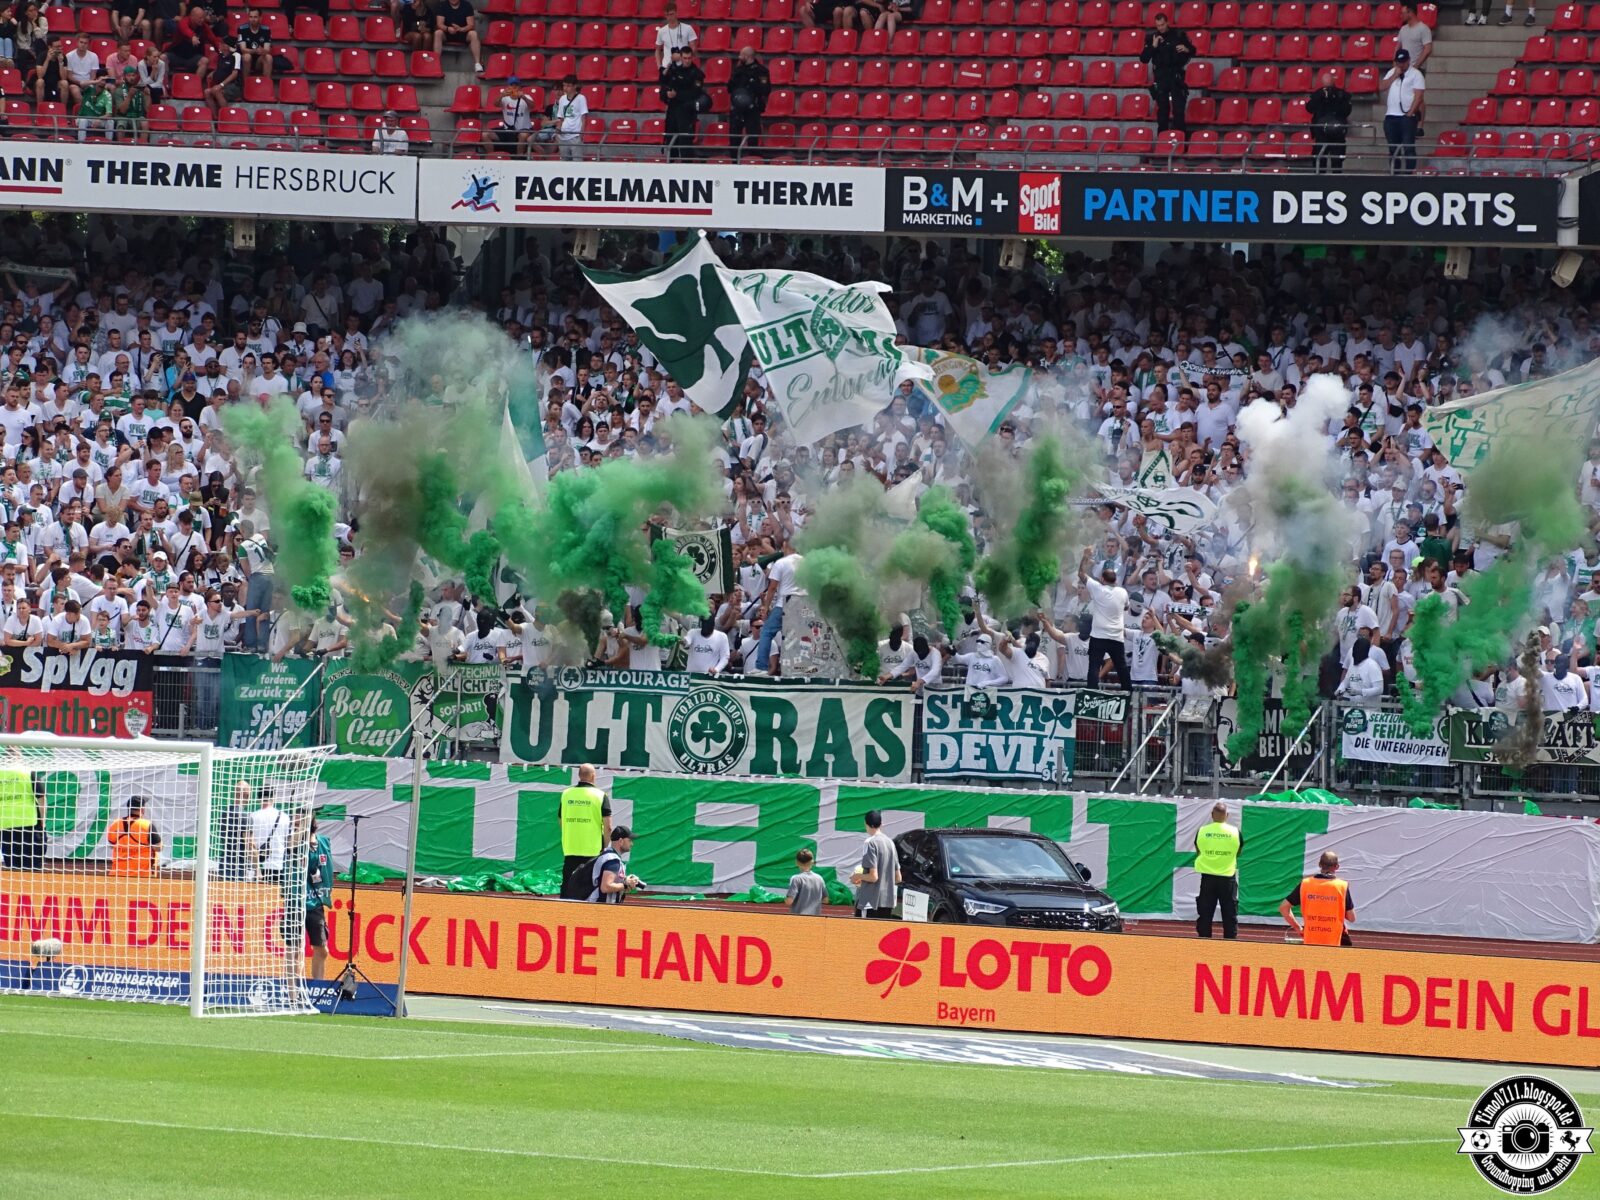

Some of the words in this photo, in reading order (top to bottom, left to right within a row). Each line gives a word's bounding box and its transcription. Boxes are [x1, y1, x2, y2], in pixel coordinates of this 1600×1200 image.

[87, 160, 222, 188] THERME
[236, 165, 396, 195] HERSBRUCK
[515, 176, 713, 204] FACKELMANN
[734, 180, 854, 206] THERME
[903, 176, 983, 213] B&M
[1020, 177, 1060, 217] Sport
[1084, 188, 1260, 223] PARTNER
[1273, 190, 1348, 225] DES
[1034, 213, 1059, 231] Bild
[21, 648, 138, 698] SpVgg
[270, 662, 289, 673] Wir
[586, 669, 690, 689] ENTOURAGE
[239, 686, 282, 698] Zurück
[330, 686, 392, 718] Bella
[0, 695, 124, 737] reuther
[251, 703, 307, 734] SpVgg
[440, 701, 481, 717] SOFORT!
[674, 691, 721, 723] HORIDOS
[724, 700, 743, 725] 1000
[229, 730, 283, 751] Fürth
[346, 717, 401, 747] Ciao
[1259, 735, 1281, 758] BEI
[1354, 737, 1371, 748] DIE
[1374, 740, 1450, 757] UNTERHOPFTEN
[680, 752, 735, 772] ULTRAS
[927, 735, 1067, 771] DEVIA
[128, 900, 244, 954] DEN
[447, 917, 499, 970] IN
[517, 921, 598, 977] DIE
[615, 928, 784, 989] HAND.
[94, 970, 180, 988] NÜRNBERGER
[940, 937, 1112, 997] LOTTO
[1194, 963, 1364, 1024] NIMM
[1382, 974, 1515, 1033] DEIN
[937, 1001, 996, 1025] Bayern
